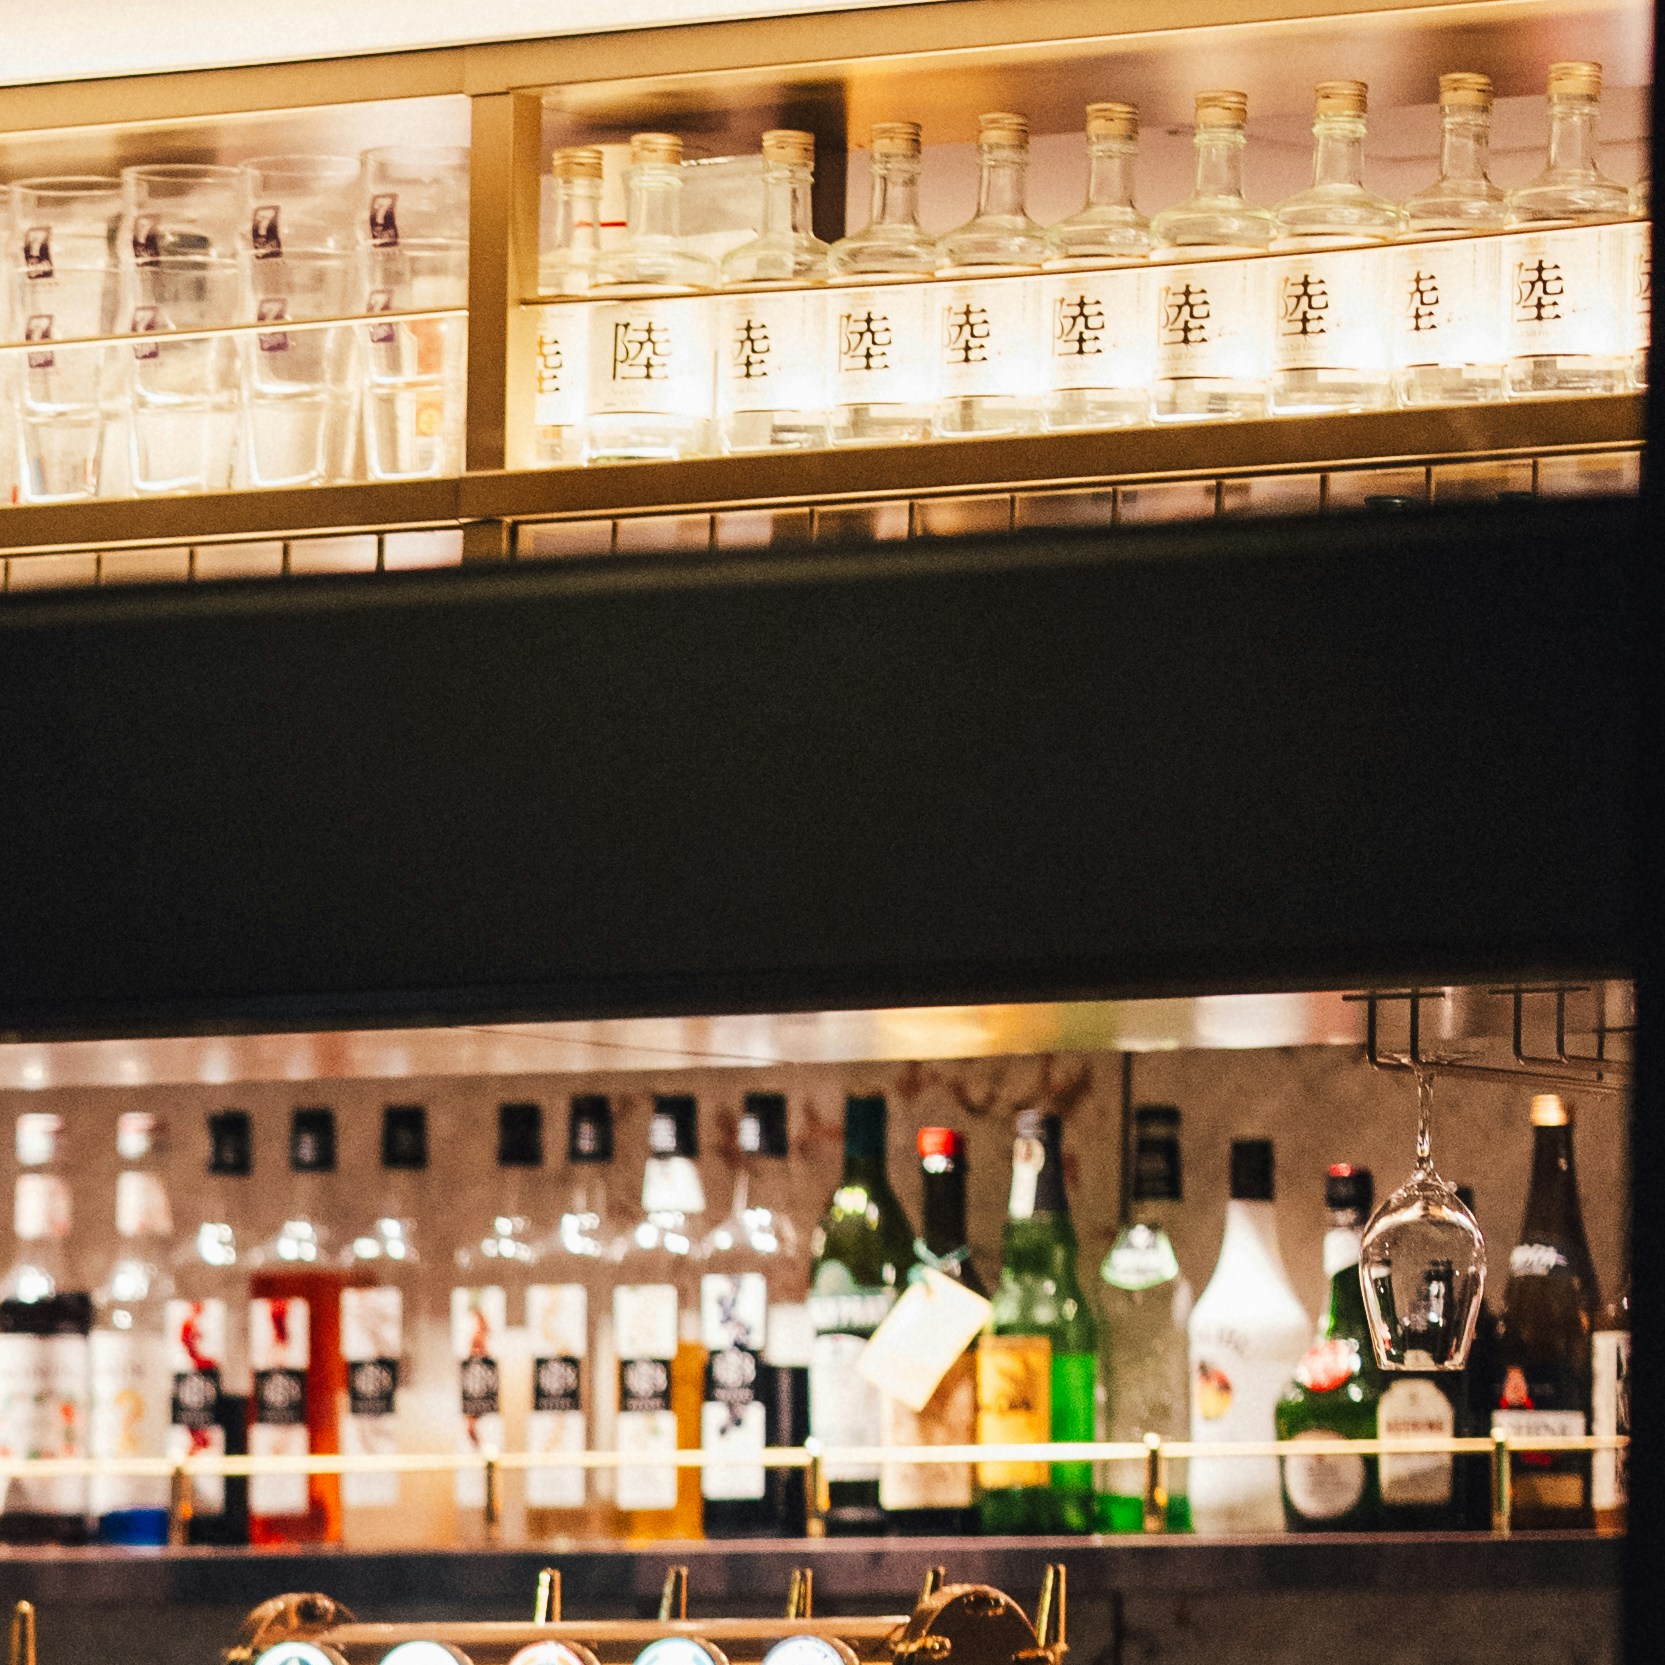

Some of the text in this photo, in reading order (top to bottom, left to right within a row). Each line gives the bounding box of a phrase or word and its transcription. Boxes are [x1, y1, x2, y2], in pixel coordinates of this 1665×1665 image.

[1158, 283, 1211, 347] 陸
[1276, 274, 1329, 339] 陸
[1511, 260, 1564, 322] 陸
[613, 321, 672, 381] 陸
[838, 311, 892, 373] 陸
[942, 304, 990, 364] 陸
[1052, 295, 1105, 357] 陸
